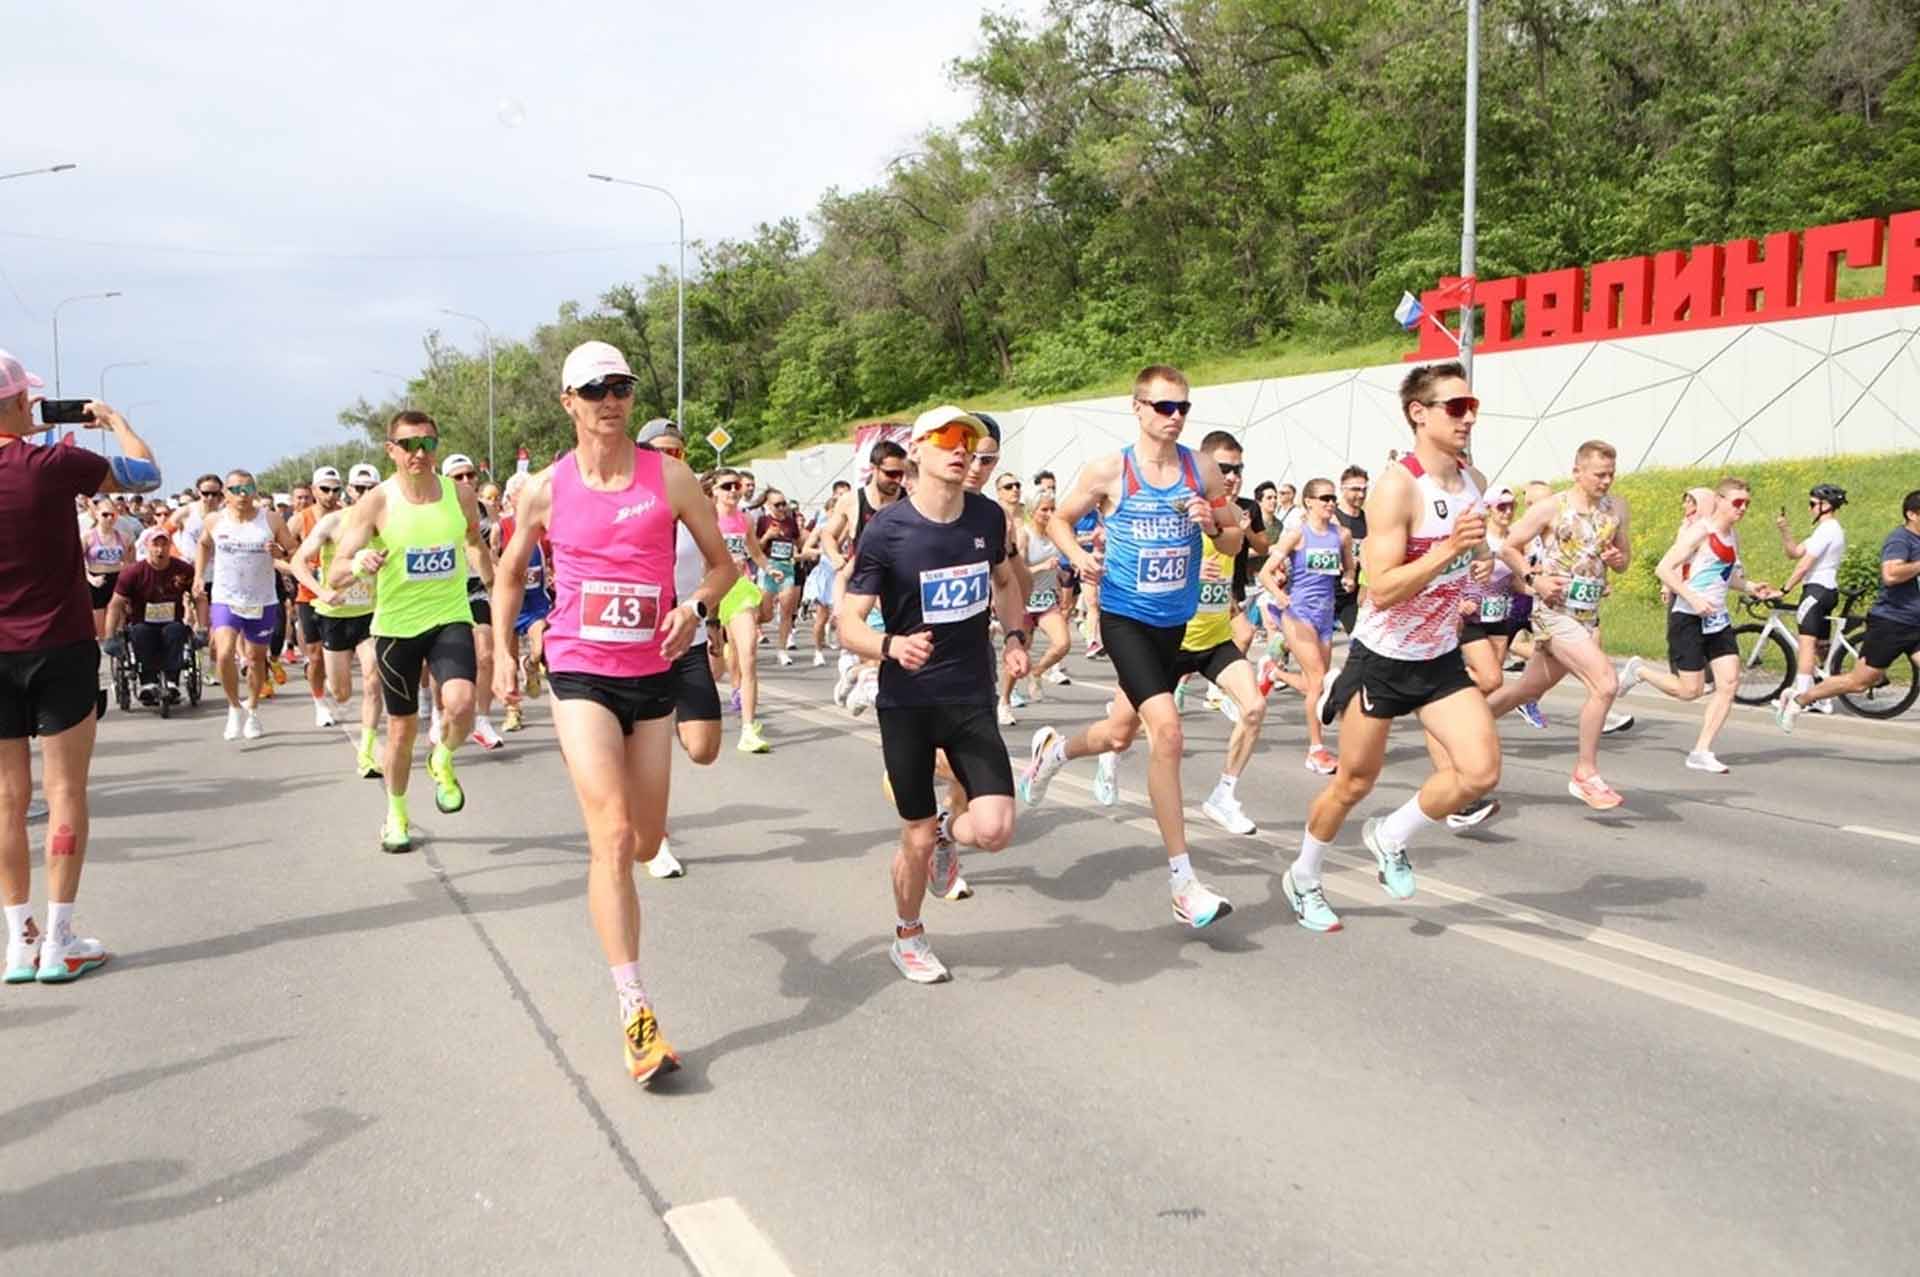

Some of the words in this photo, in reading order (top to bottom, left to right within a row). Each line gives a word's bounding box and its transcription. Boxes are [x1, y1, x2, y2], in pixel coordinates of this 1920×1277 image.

[412, 551, 452, 571] 466
[1146, 558, 1185, 581] 548
[931, 576, 982, 609] 421
[600, 596, 642, 628] 43
